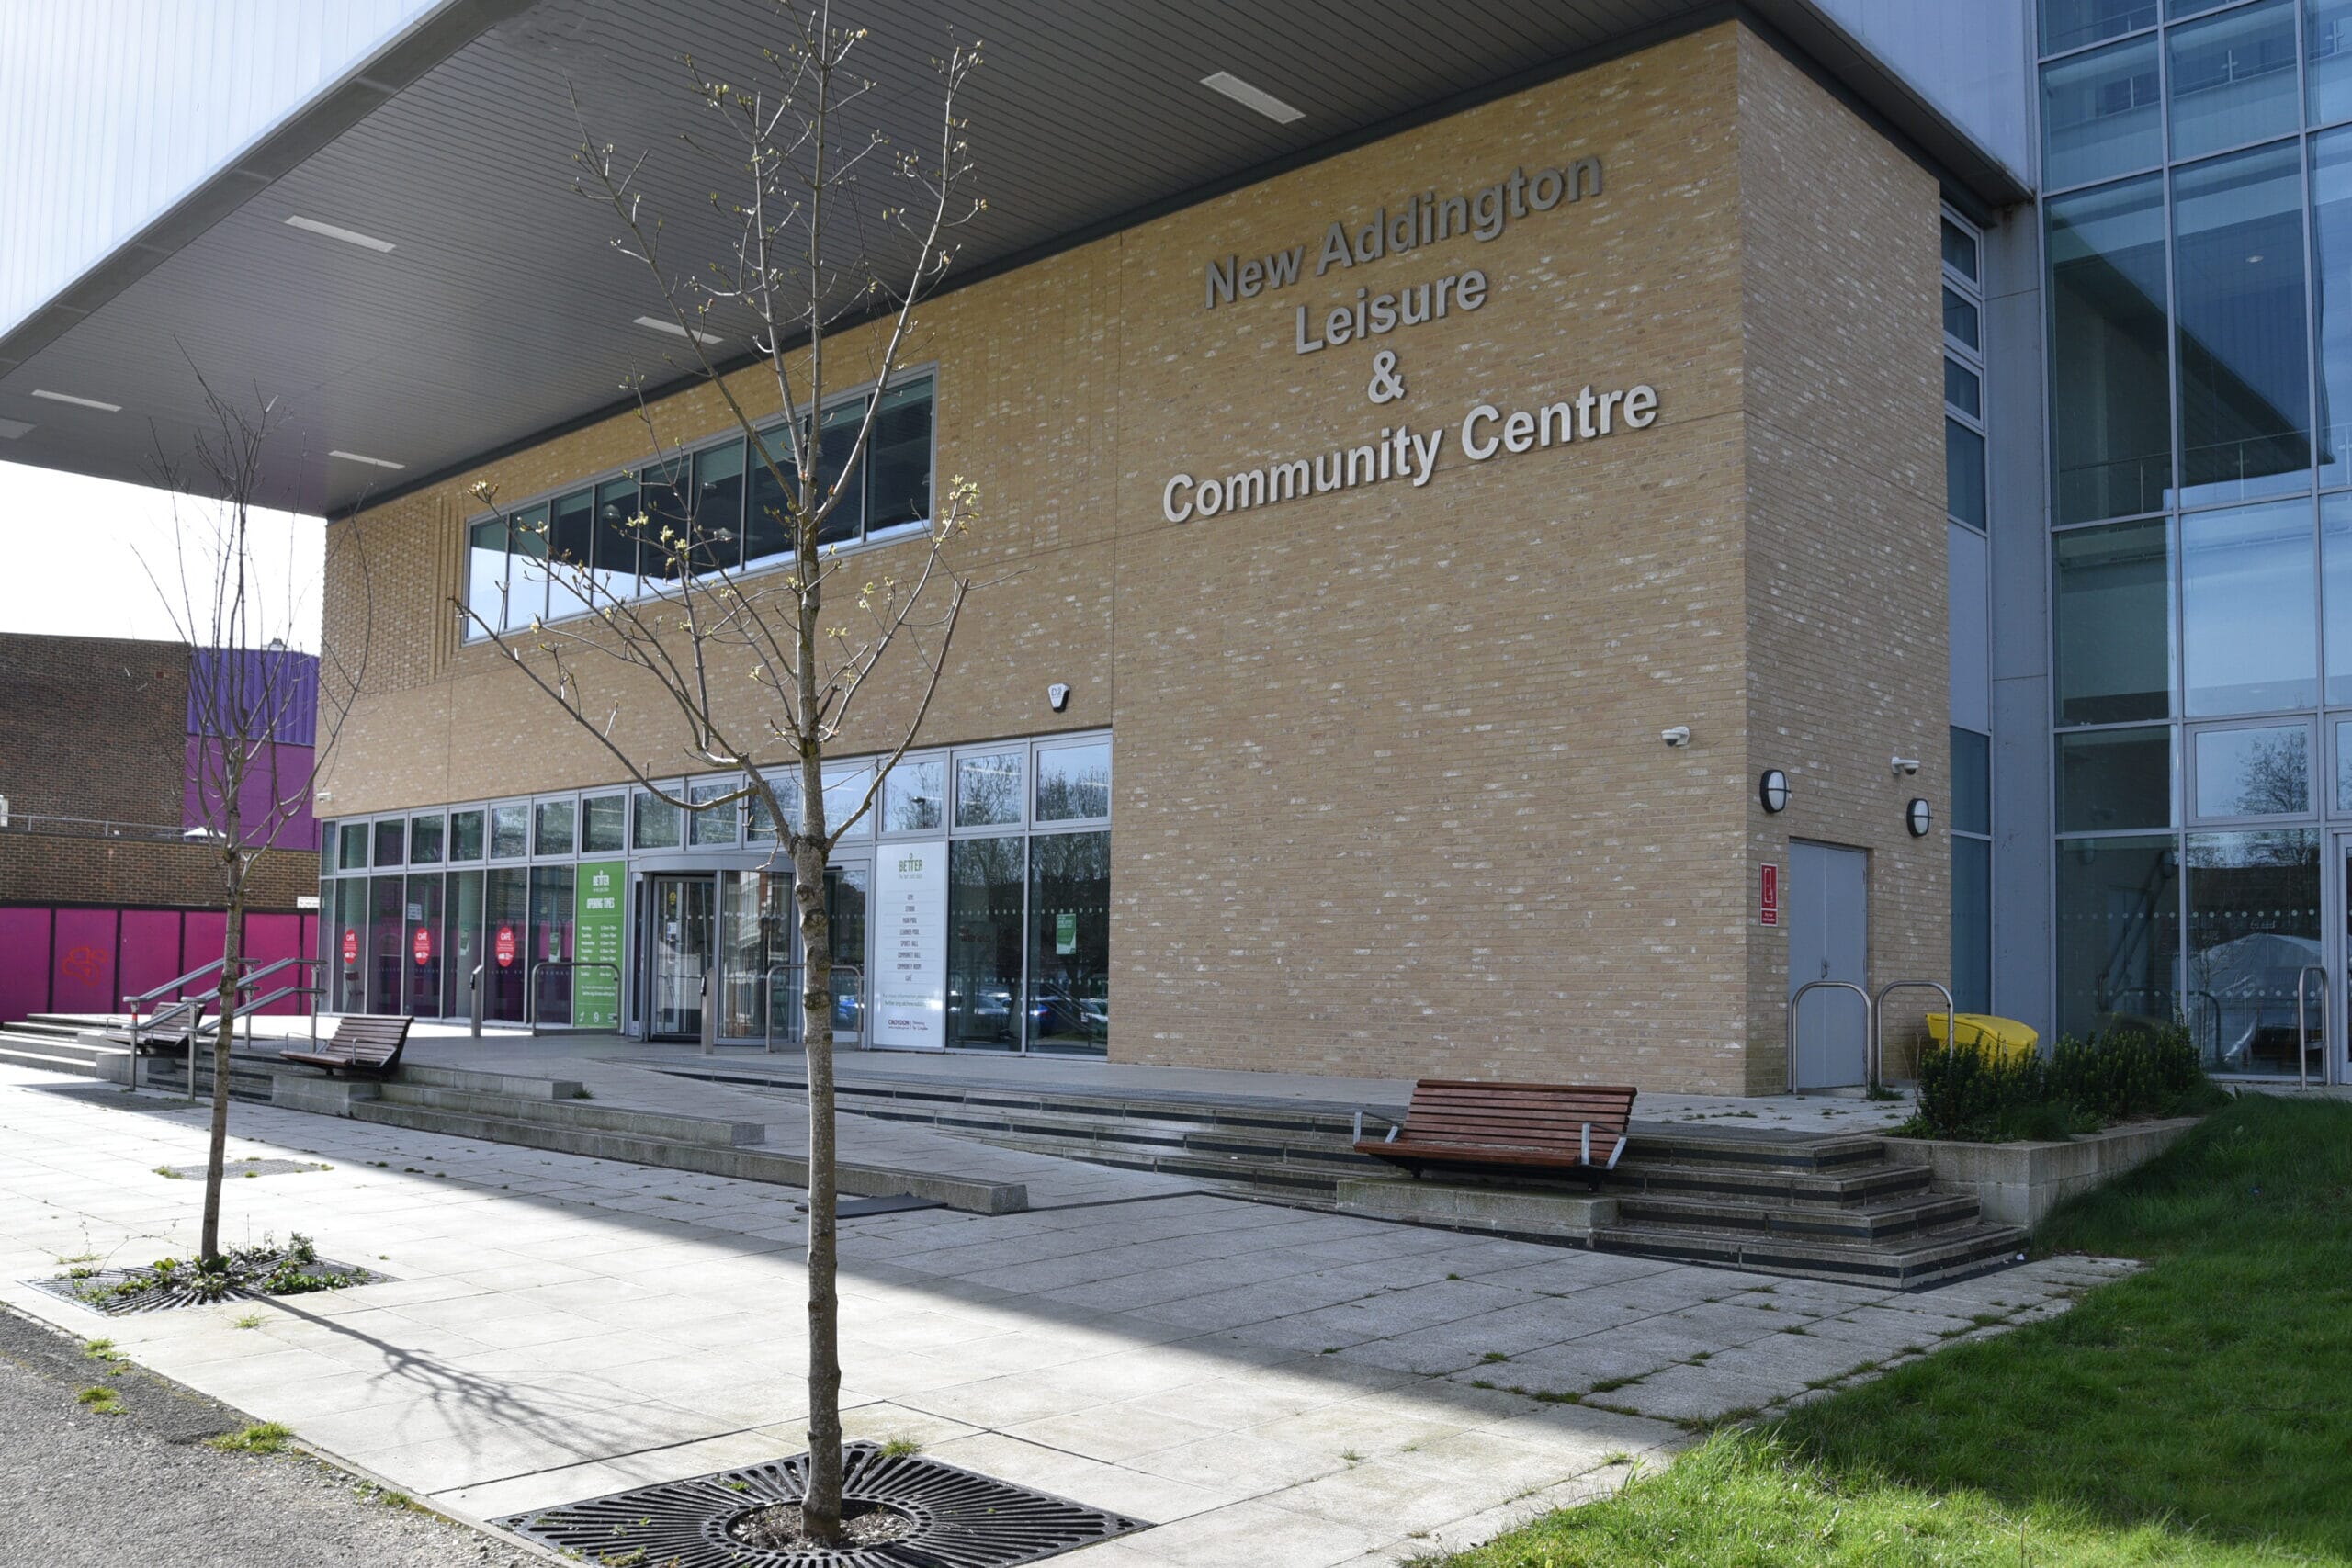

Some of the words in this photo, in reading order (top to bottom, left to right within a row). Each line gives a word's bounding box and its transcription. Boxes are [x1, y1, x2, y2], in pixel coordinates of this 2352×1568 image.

[1204, 243, 1305, 309] New
[1316, 155, 1603, 276] Addington
[1295, 268, 1487, 355] Leisure
[1367, 349, 1405, 404] &
[1162, 425, 1444, 523] Community
[1461, 383, 1658, 460] Centre
[899, 859, 923, 872] BETTER
